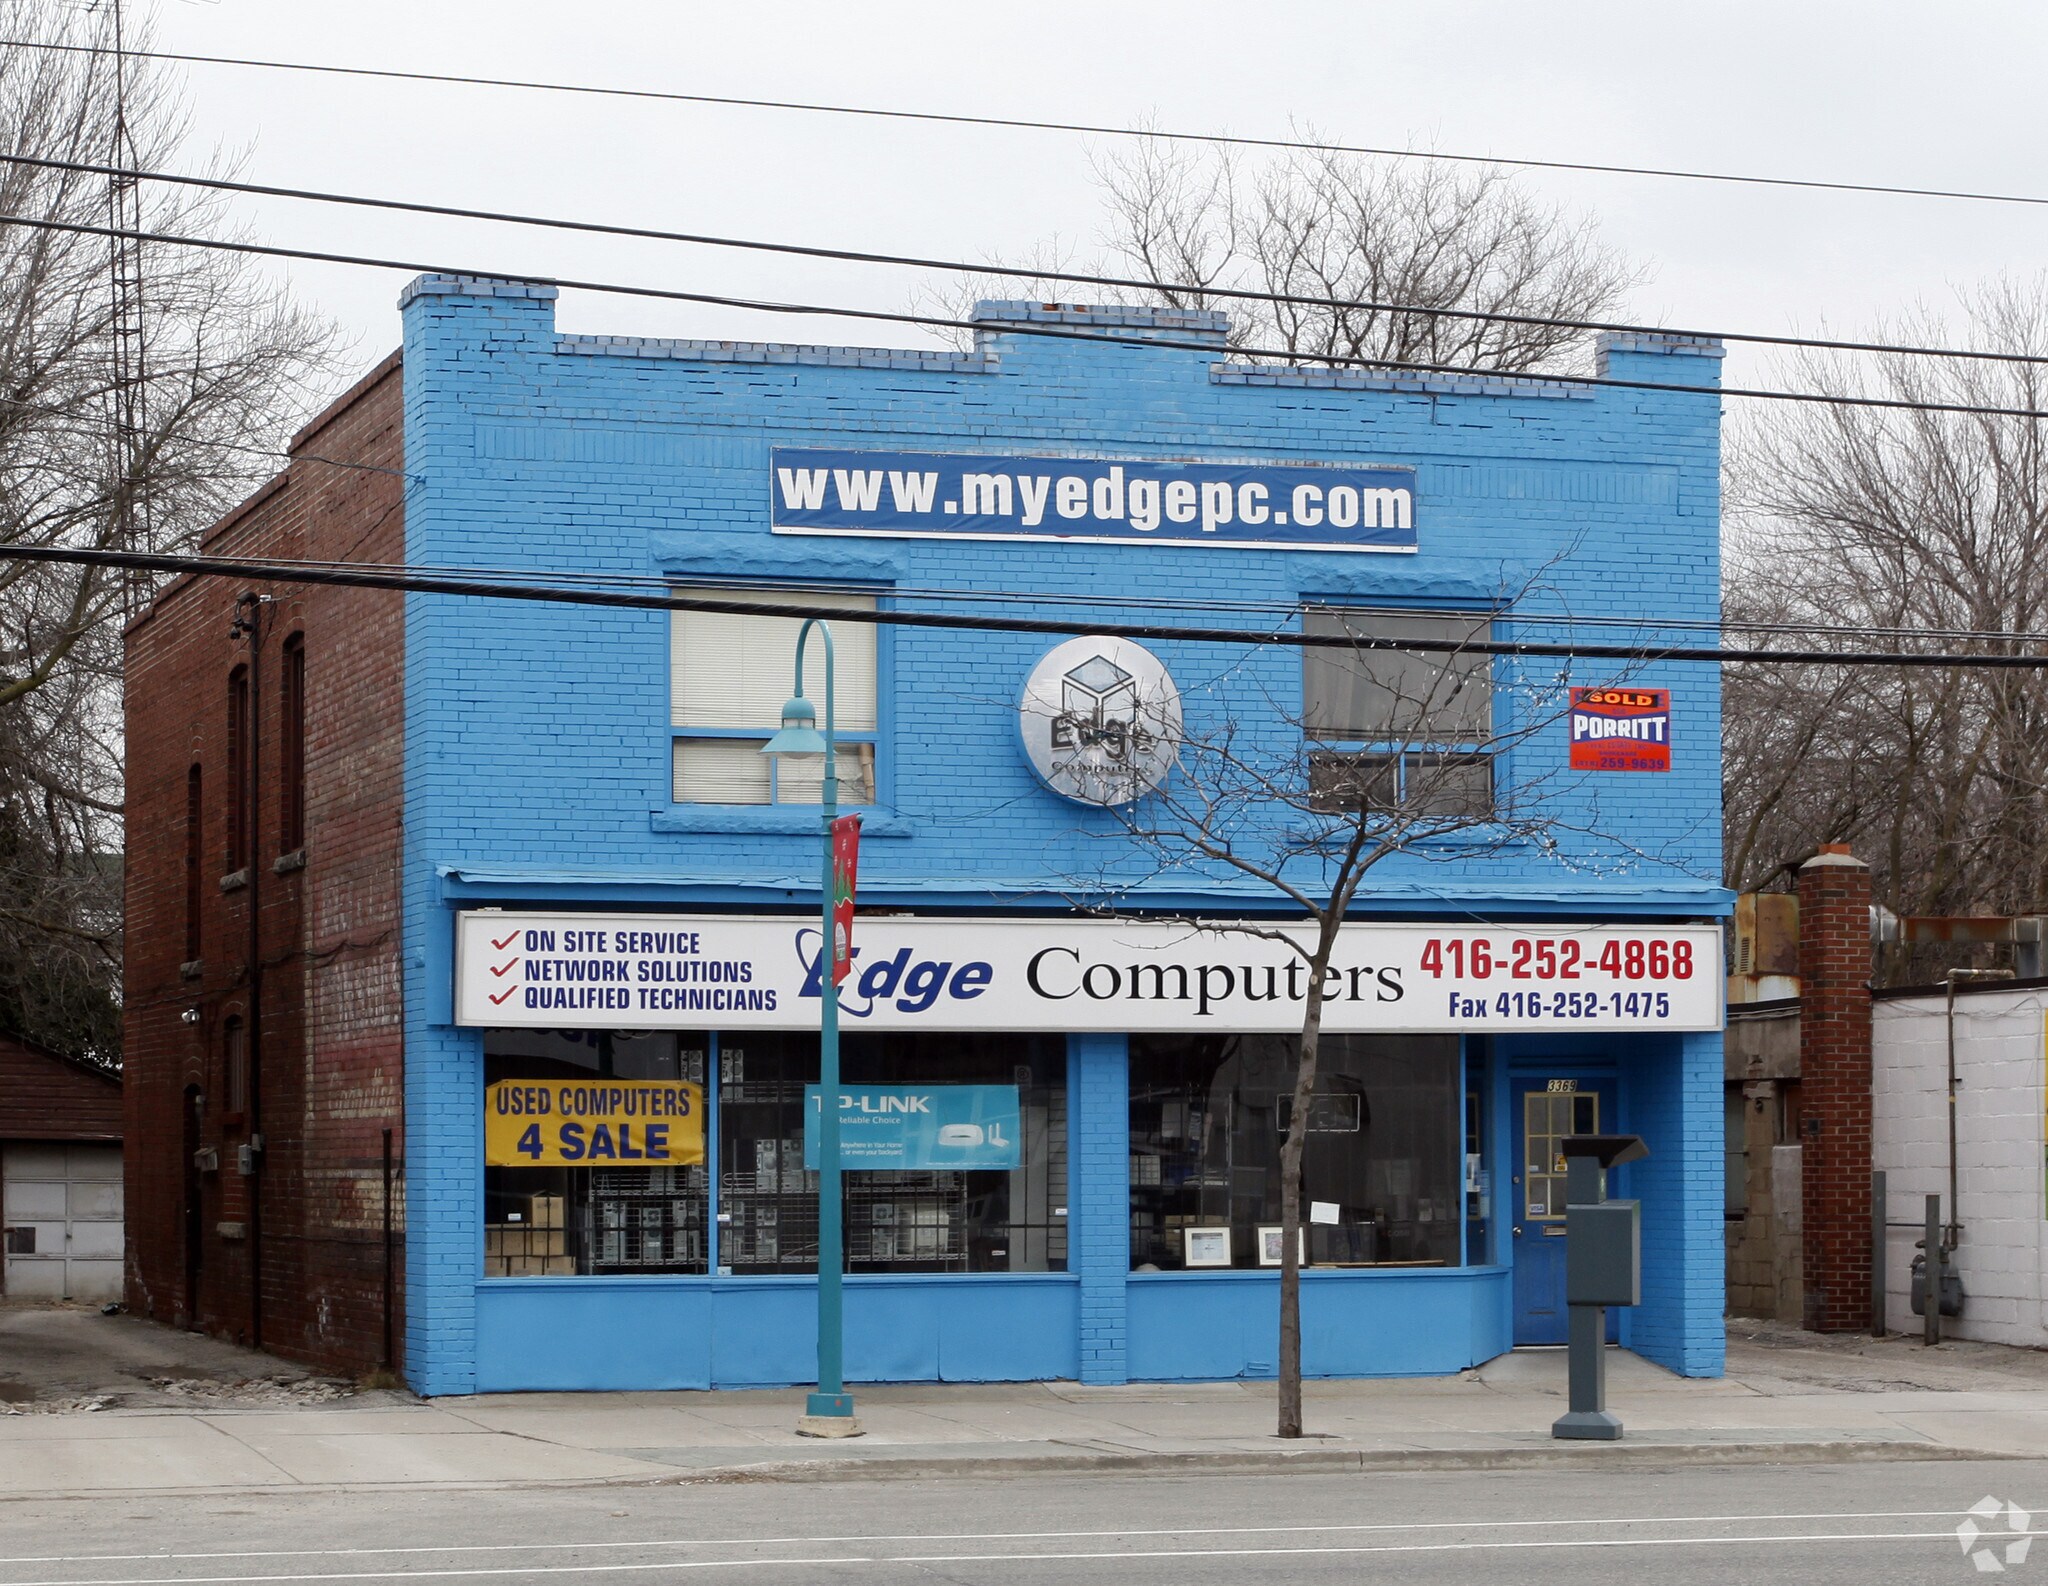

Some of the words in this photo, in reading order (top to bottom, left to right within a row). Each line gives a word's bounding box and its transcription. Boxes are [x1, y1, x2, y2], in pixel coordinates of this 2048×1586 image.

[777, 466, 1412, 532] www.myedgepc.com
[1589, 692, 1653, 707] SOLD
[1573, 714, 1667, 742] PORRITT
[1600, 757, 1665, 769] 259-9639
[525, 930, 556, 952] ON
[564, 930, 608, 954] SITE
[615, 931, 700, 955] SERVICE
[525, 959, 630, 982] NETWORK
[637, 960, 753, 984] SOLUTIONS
[1420, 938, 1694, 980] 416-252-4868
[1026, 946, 1405, 1016] Computers
[524, 986, 630, 1010] QUALIFIED
[638, 987, 777, 1012] TECHNICIANS
[1449, 991, 1488, 1018] Fax
[1495, 991, 1670, 1018] 416-252-1475
[1548, 1080, 1577, 1092] 3369
[496, 1087, 552, 1116] USED
[559, 1087, 691, 1117] COMPUTERS
[872, 1116, 901, 1124] Choice
[517, 1123, 544, 1160] 4
[559, 1122, 671, 1161] SALE
